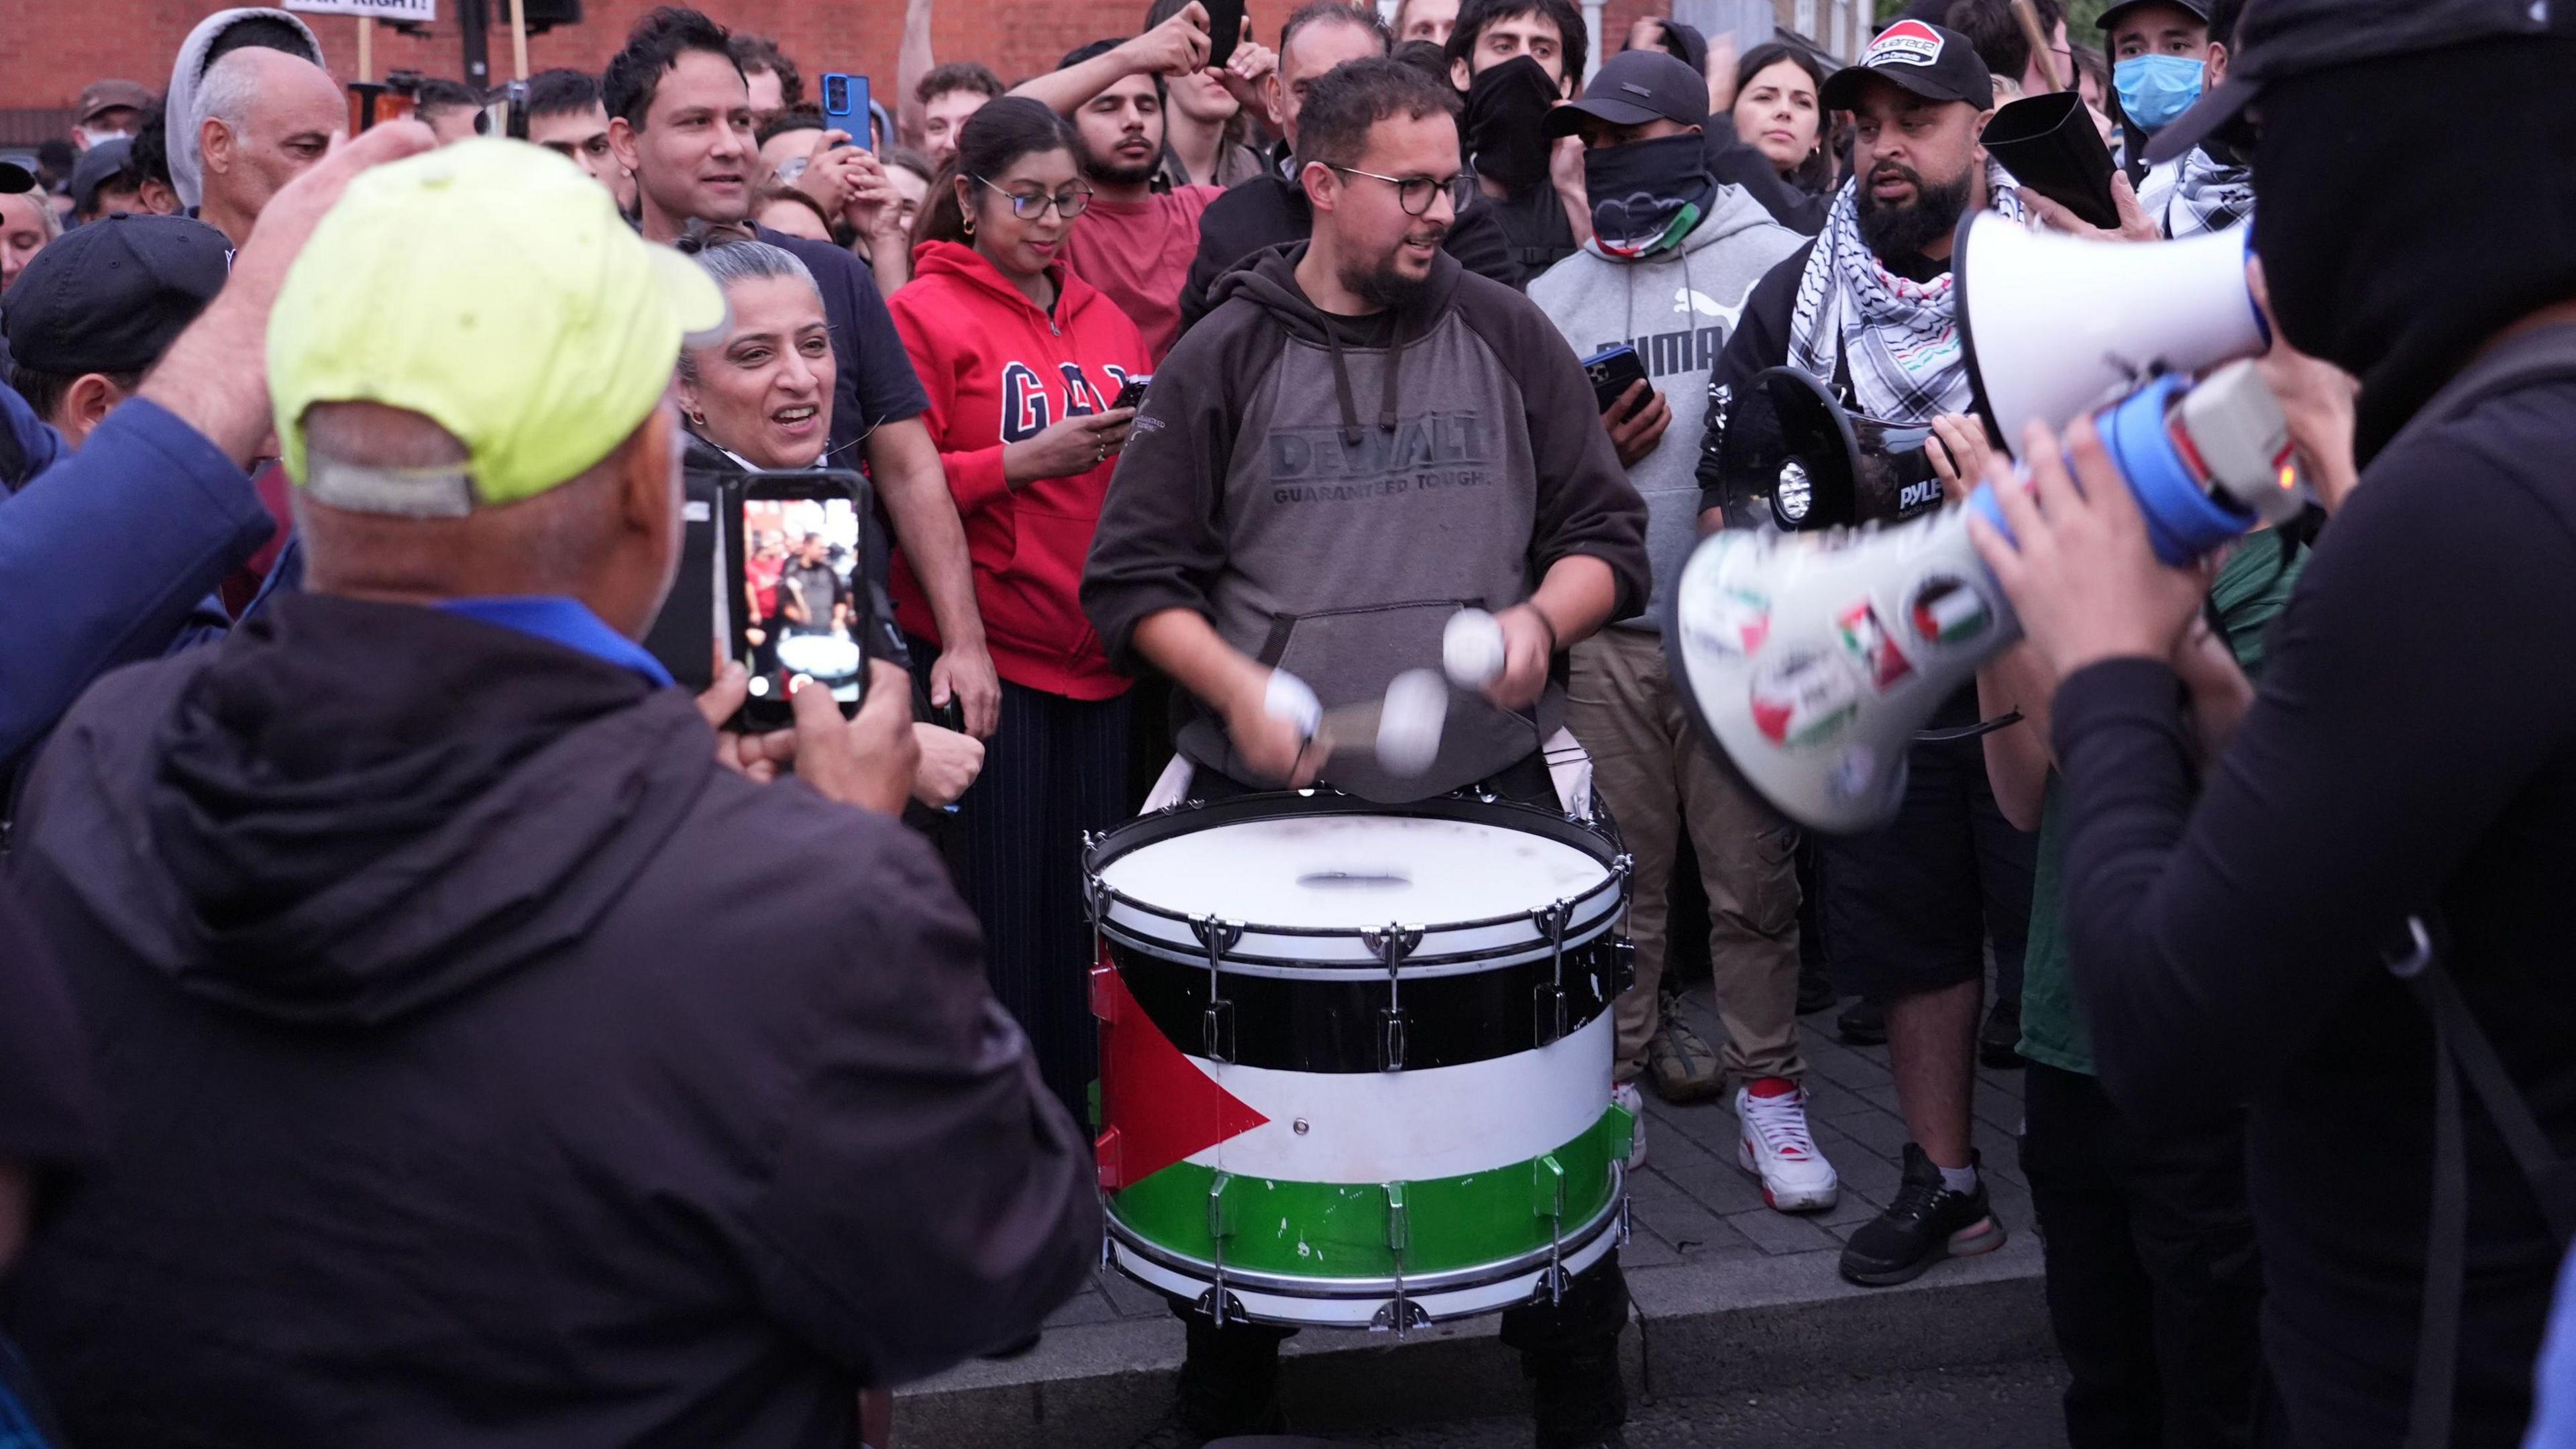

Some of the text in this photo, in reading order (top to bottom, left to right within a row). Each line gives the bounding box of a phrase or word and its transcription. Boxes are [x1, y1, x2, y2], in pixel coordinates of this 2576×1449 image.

[354, 0, 426, 10] GHT!
[1597, 326, 1723, 377] MA
[1274, 479, 1408, 502] GUARANTEED
